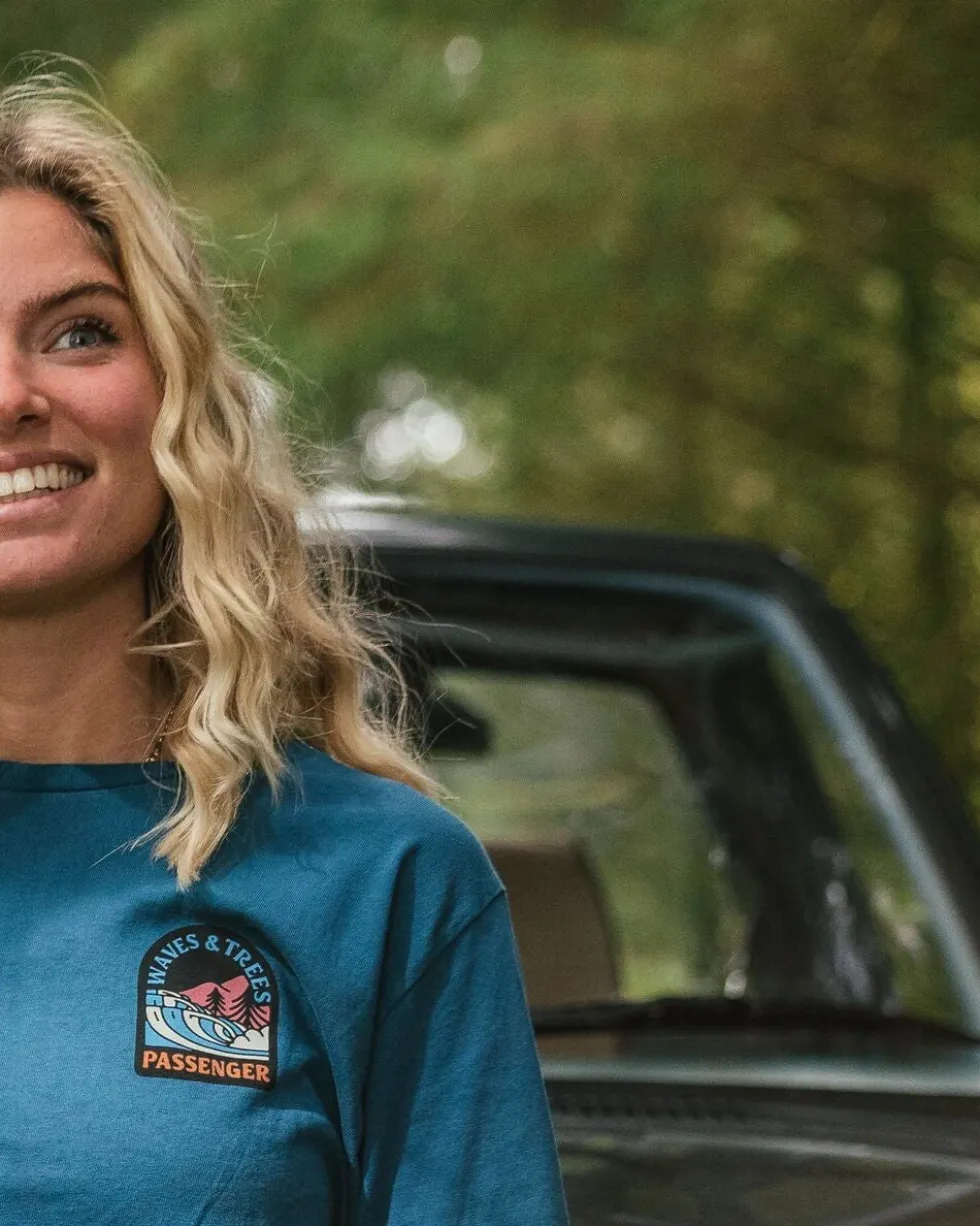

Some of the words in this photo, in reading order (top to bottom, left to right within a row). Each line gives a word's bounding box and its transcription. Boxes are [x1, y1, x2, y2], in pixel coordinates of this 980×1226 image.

[146, 933, 200, 985] WAVES
[204, 934, 220, 952] &
[224, 938, 271, 1004] TREES
[142, 1050, 270, 1083] PASSENGER
